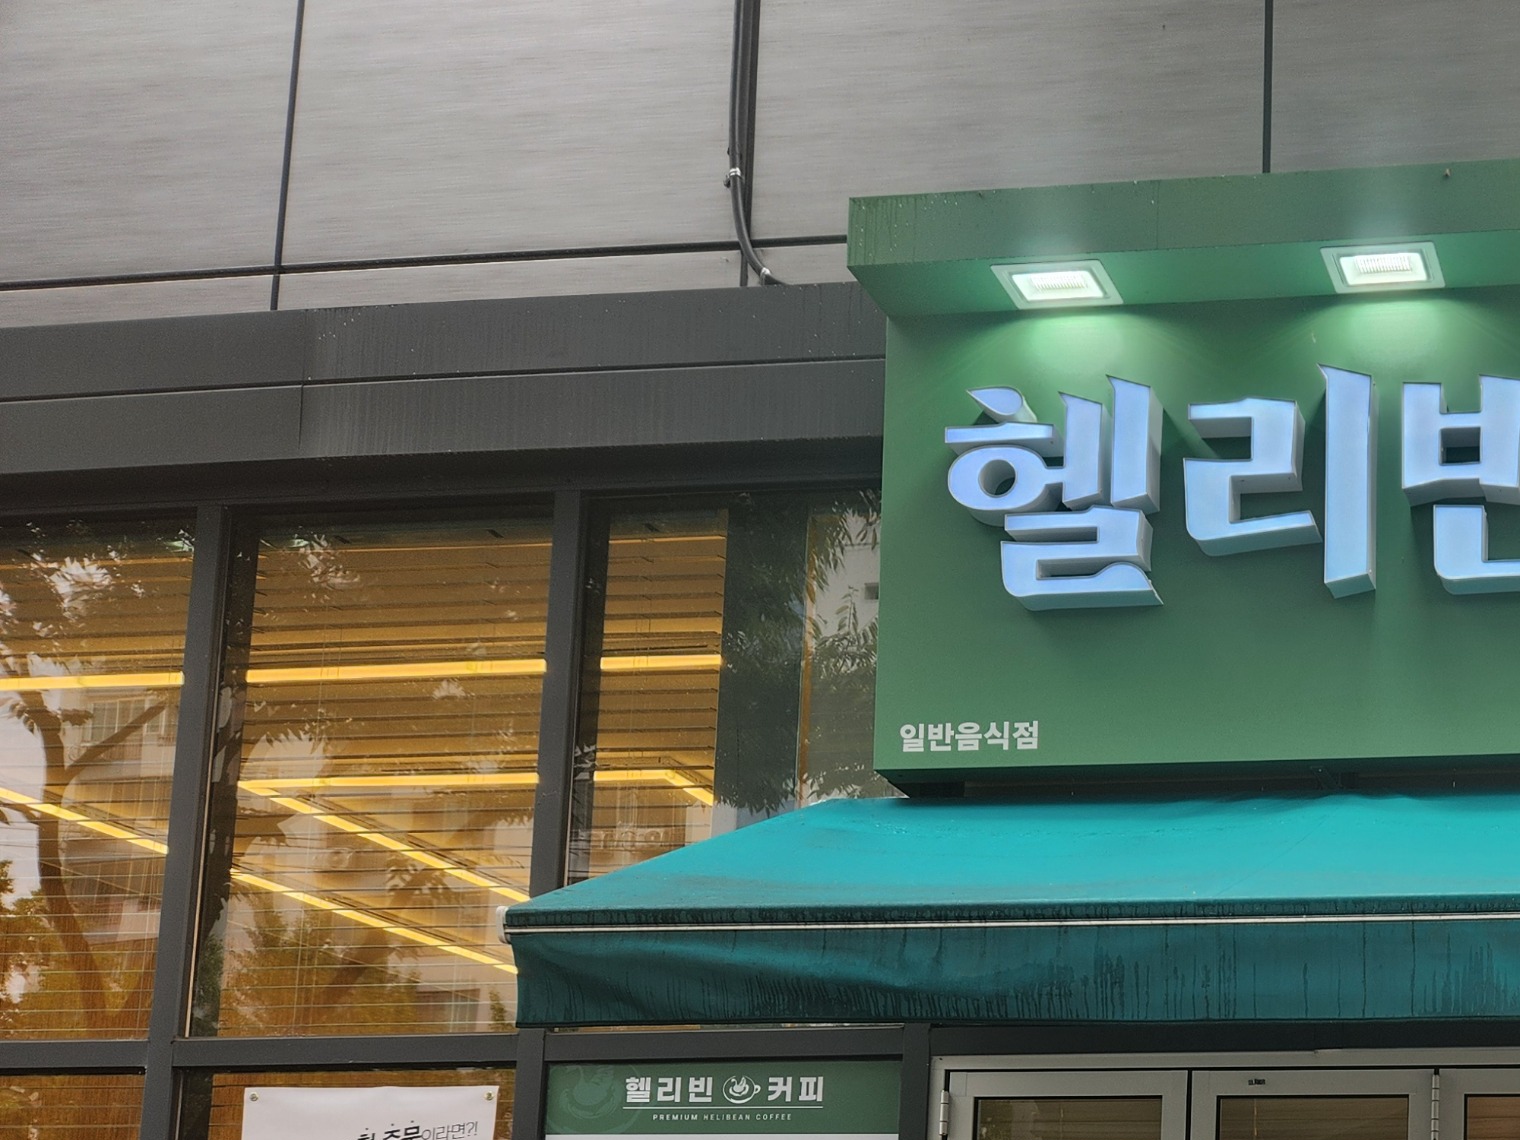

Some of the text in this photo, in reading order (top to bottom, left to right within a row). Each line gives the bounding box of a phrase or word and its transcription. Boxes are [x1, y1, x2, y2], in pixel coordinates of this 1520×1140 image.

[900, 720, 1038, 752] 일반음식점
[625, 1076, 824, 1103] 헬리빈 커피
[652, 1113, 792, 1121] PREMIUM HELIBEAN COFFEE
